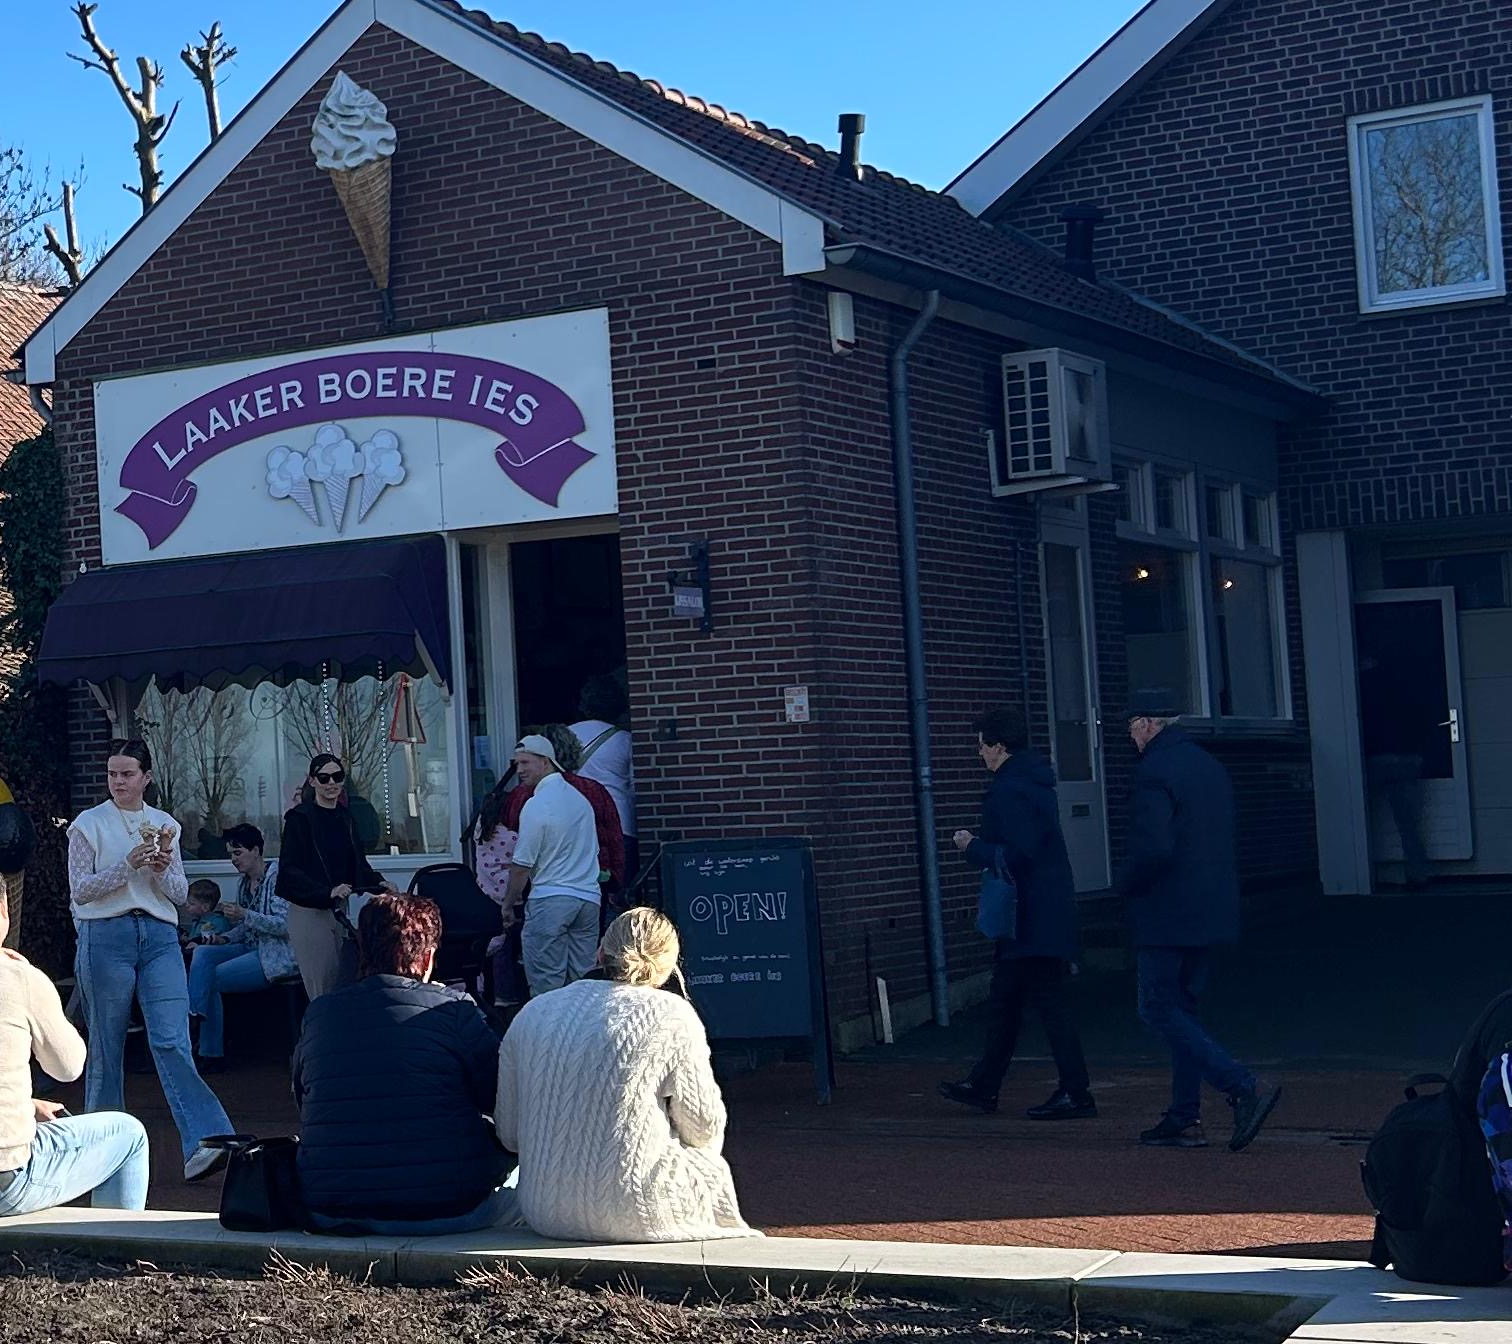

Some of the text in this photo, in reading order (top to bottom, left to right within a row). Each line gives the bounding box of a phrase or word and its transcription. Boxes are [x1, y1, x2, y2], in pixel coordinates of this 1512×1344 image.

[152, 366, 540, 472] LAAKER BOERE IES
[689, 892, 787, 935] OPEN!
